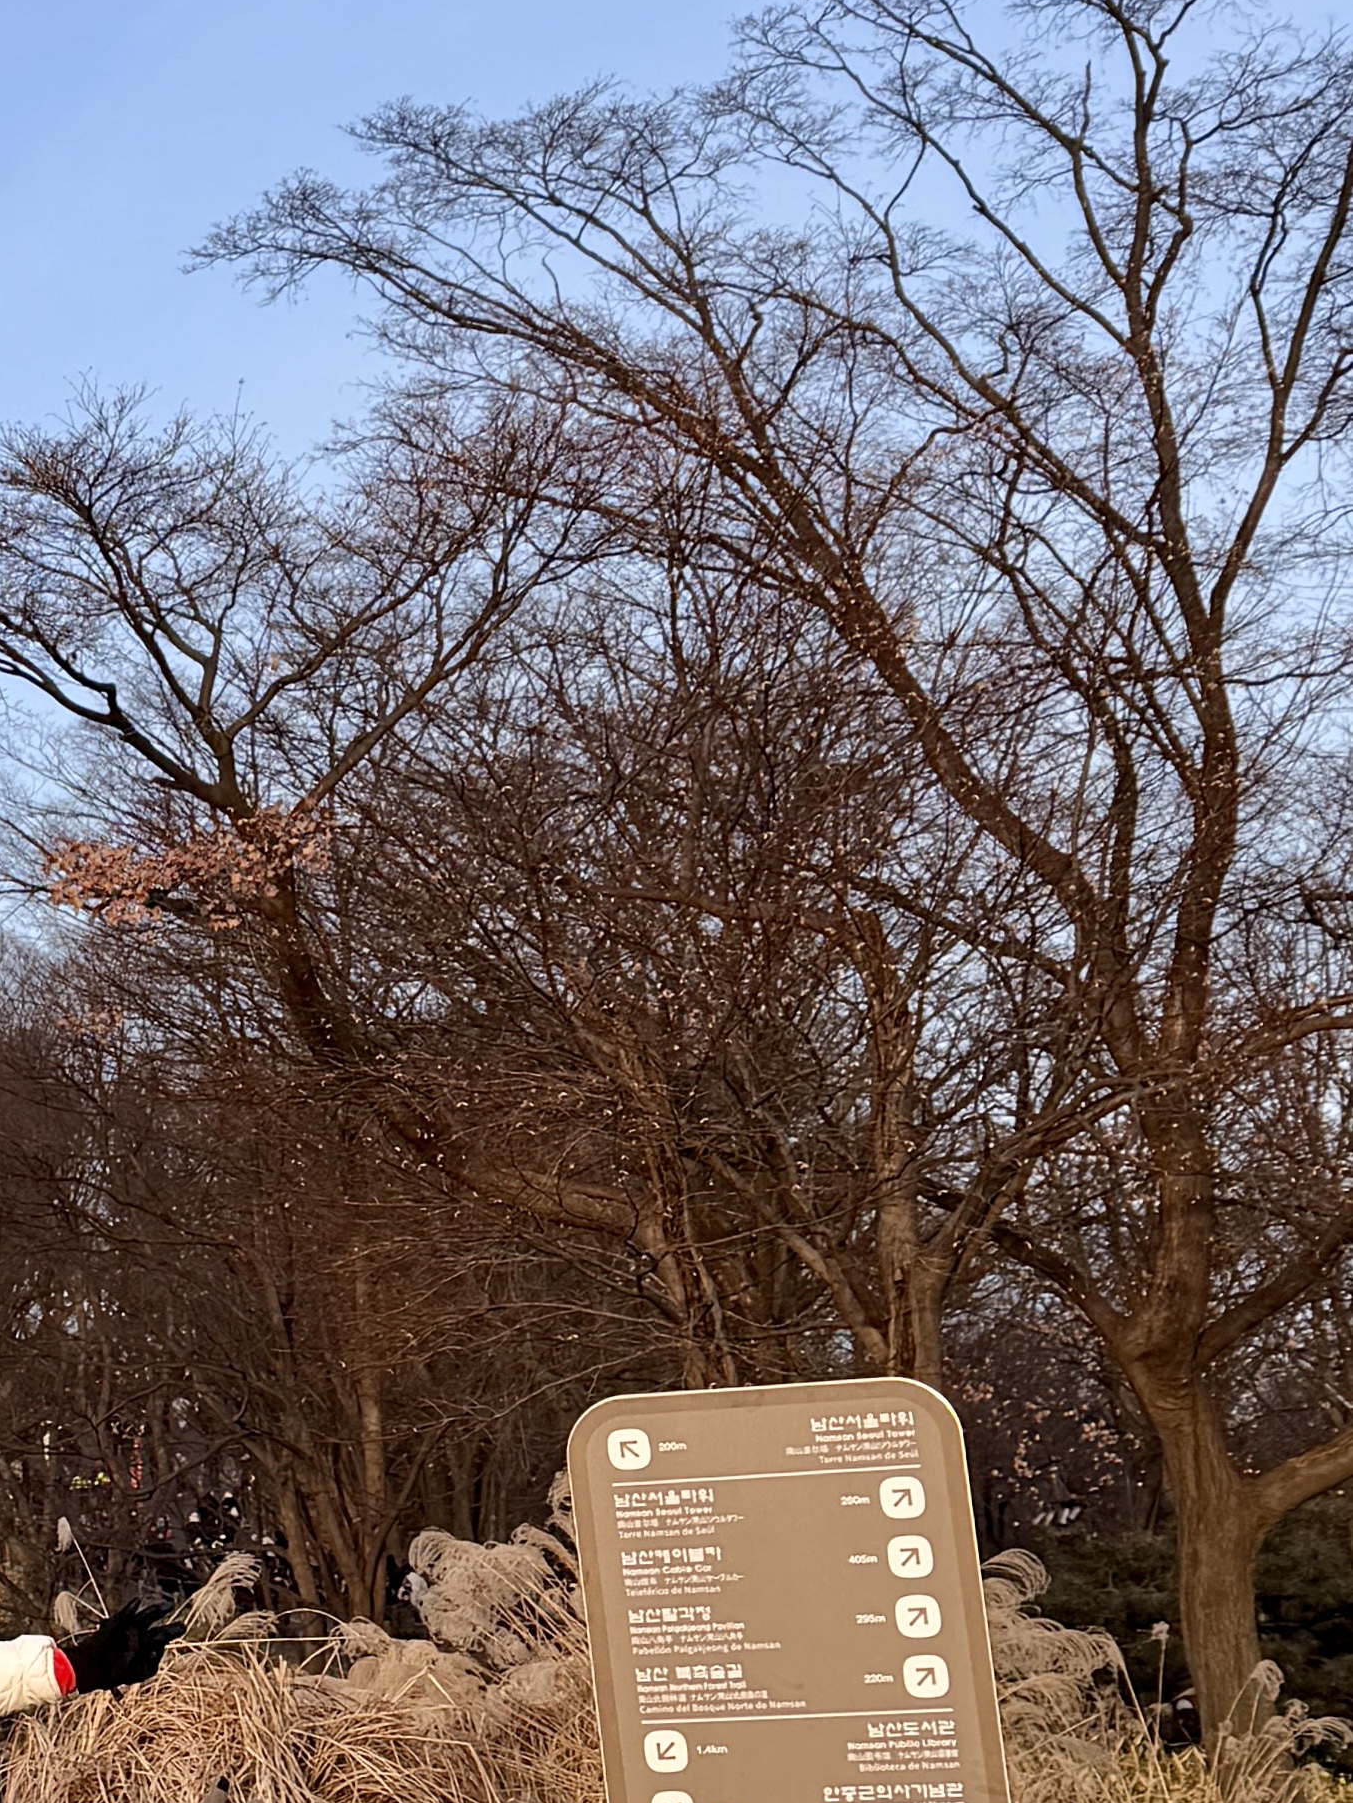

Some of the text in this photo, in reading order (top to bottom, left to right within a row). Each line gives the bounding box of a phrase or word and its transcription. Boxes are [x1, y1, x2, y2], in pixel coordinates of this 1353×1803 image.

[886, 1429, 916, 1438] Tower
[658, 1441, 688, 1452] 200m
[635, 1667, 669, 1683] 남산
[867, 1720, 956, 1738] 남산도서관
